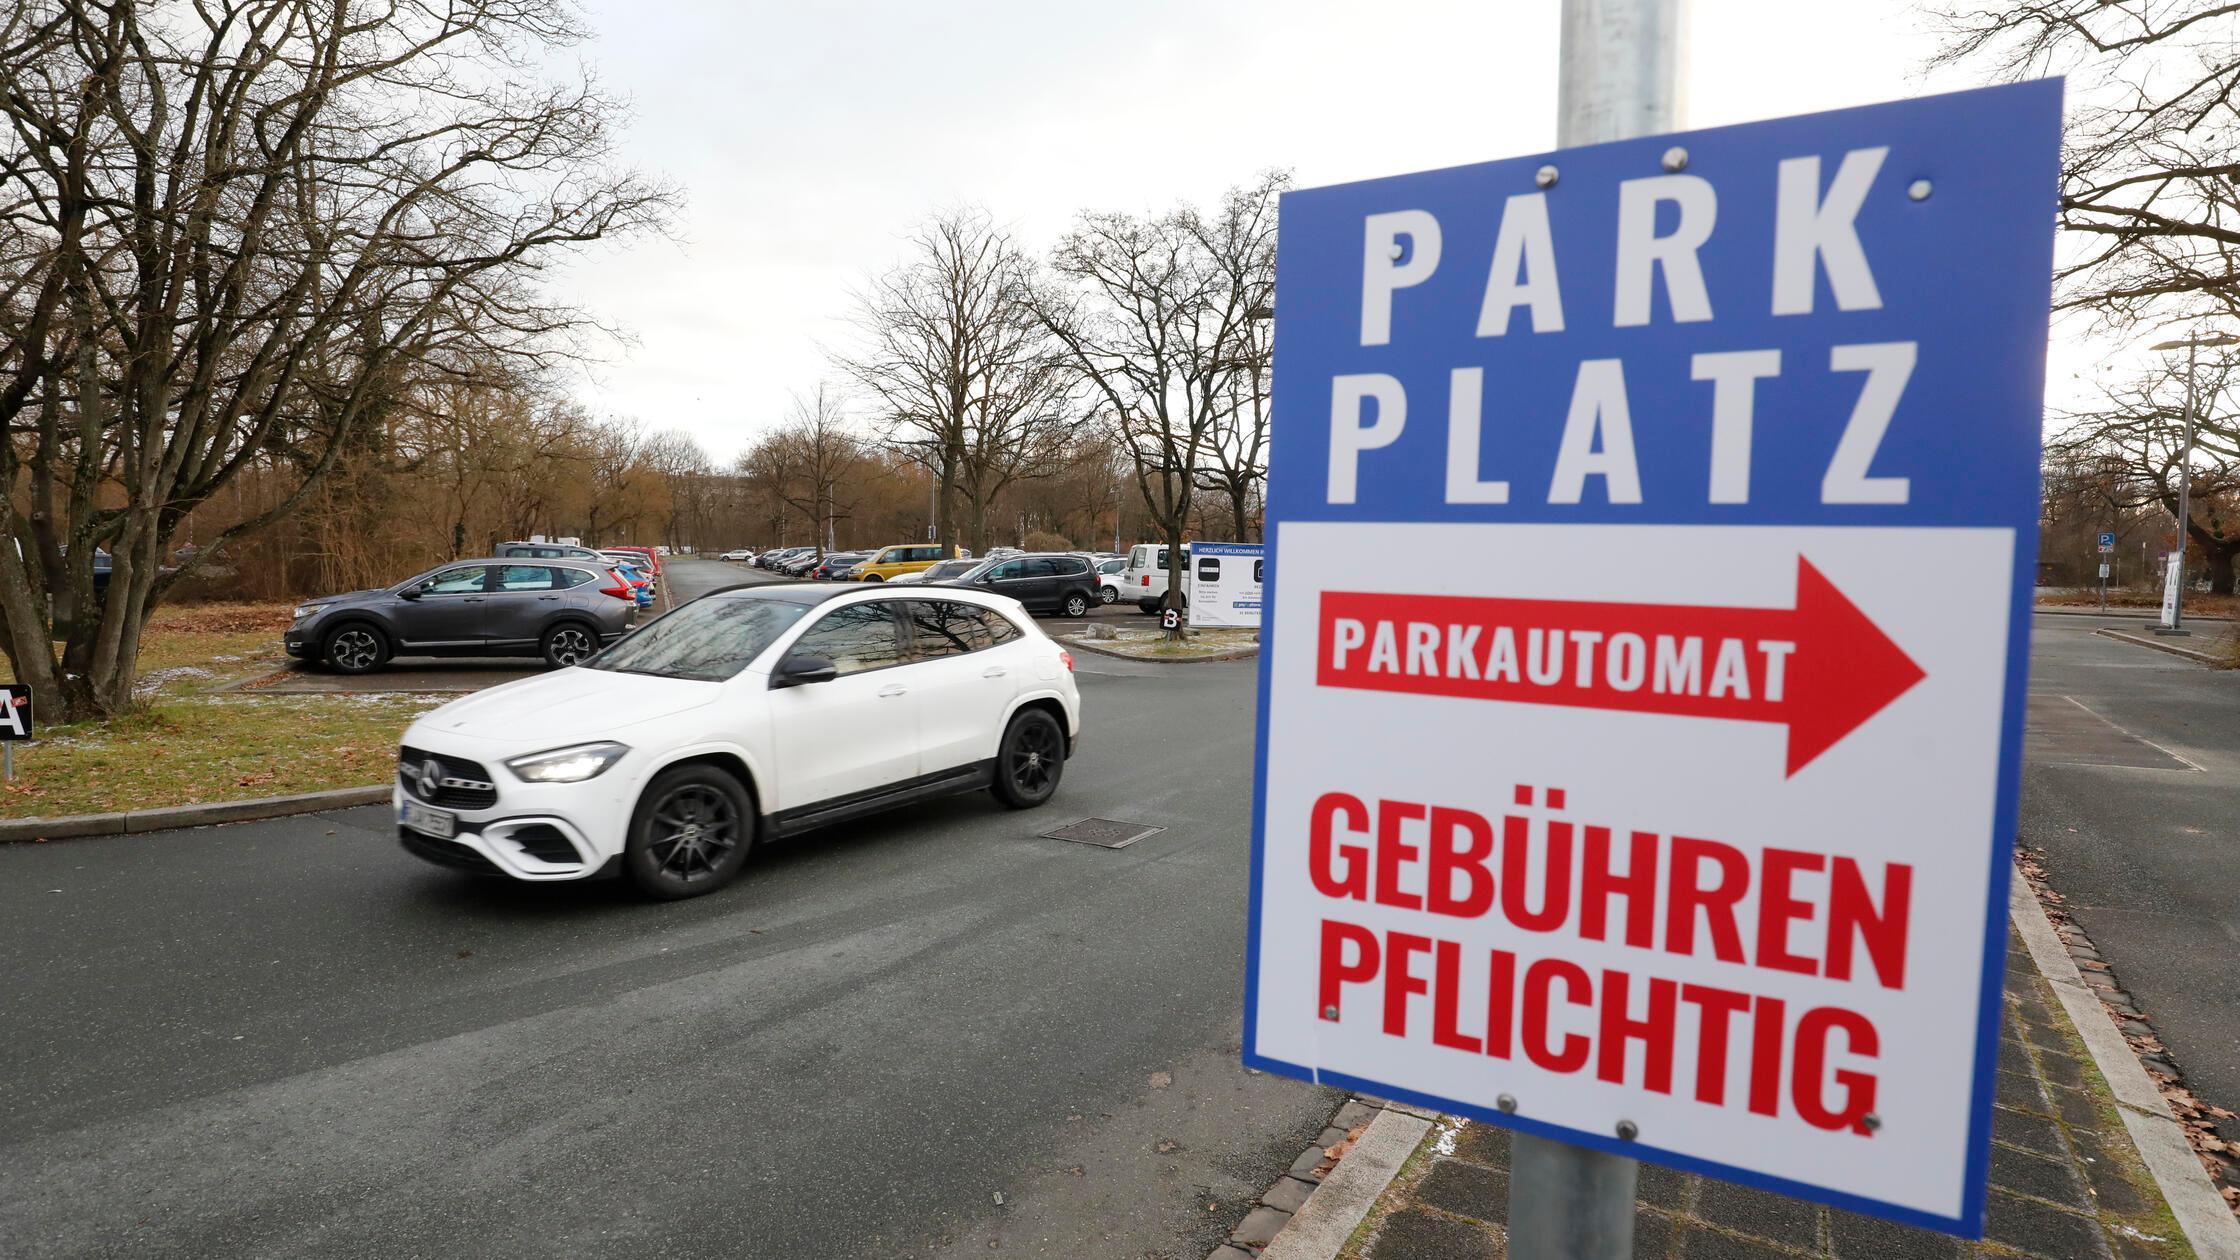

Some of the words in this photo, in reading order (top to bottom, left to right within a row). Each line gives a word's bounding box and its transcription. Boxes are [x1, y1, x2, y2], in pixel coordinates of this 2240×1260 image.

[1360, 146, 1890, 347] PARK
[1327, 341, 1918, 505] PLATZ
[0, 689, 25, 735] A
[1331, 617, 1796, 703] PARKAUTOMAT
[1308, 784, 1914, 991] GEBÜHREN
[1318, 918, 1880, 1139] PFLICHTIG
